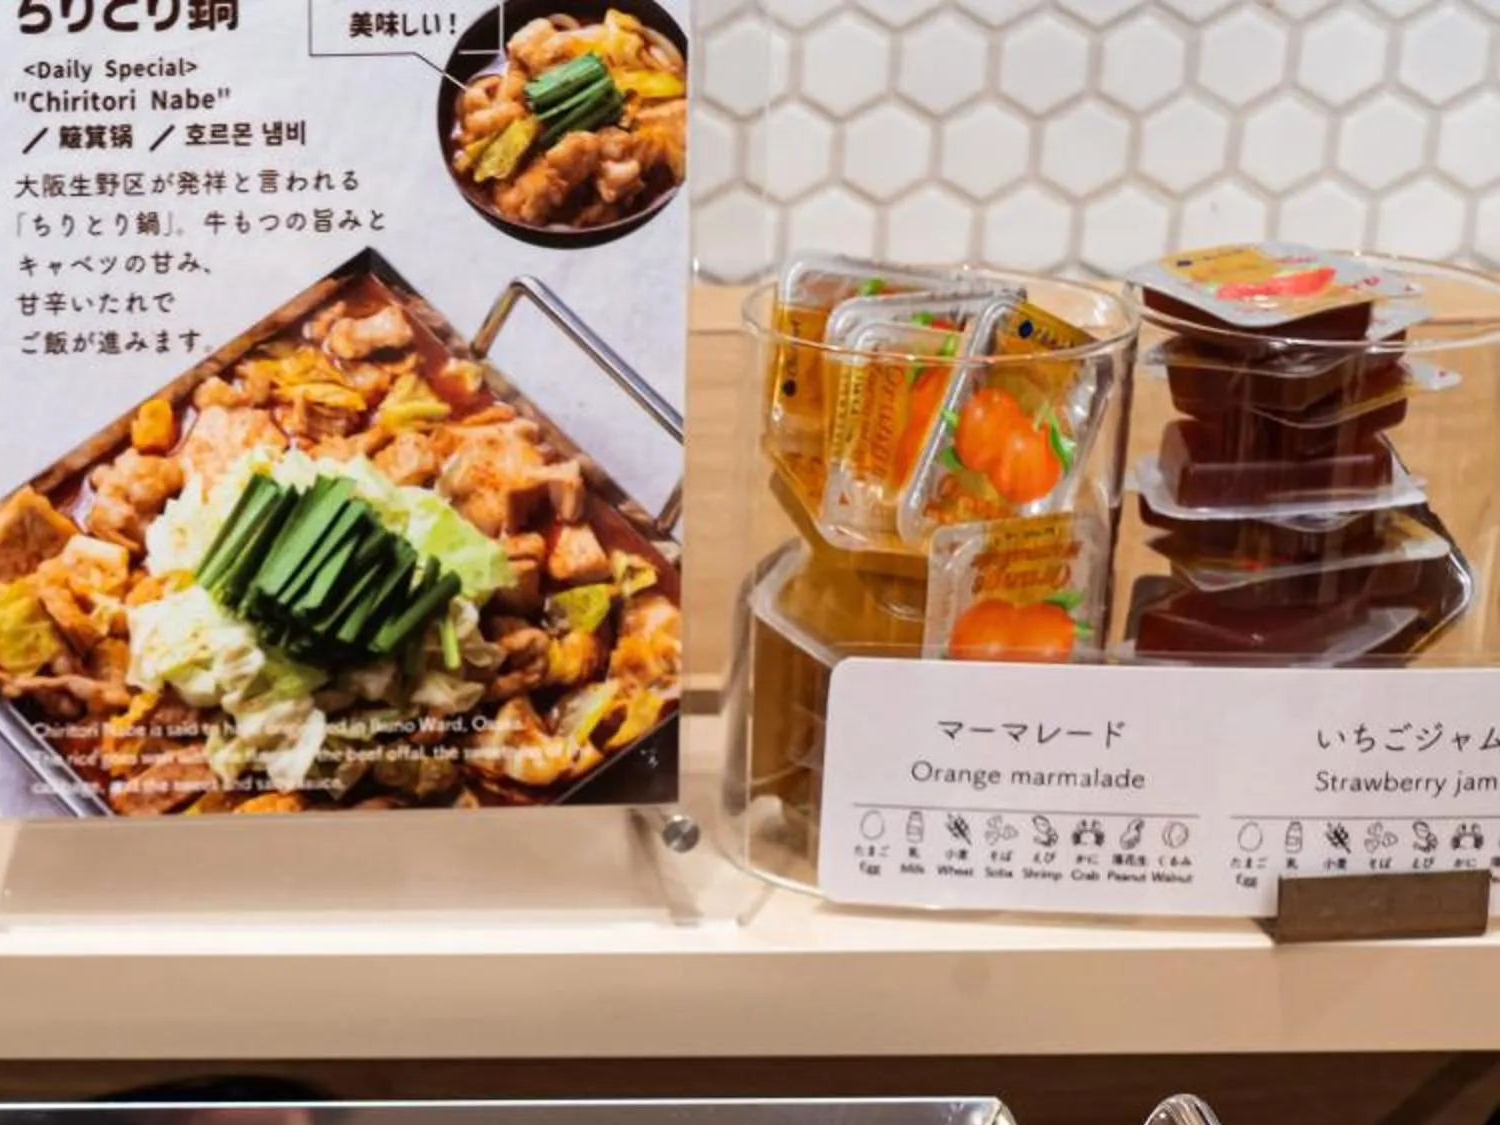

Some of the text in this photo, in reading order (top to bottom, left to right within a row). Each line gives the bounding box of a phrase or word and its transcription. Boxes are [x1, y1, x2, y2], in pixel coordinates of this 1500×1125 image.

[23, 58, 199, 82] <Daily Special>
[13, 87, 232, 113] "Chiritori Nabe"
[185, 123, 254, 147] 호르몬
[262, 120, 307, 146] 냄비
[15, 169, 360, 199] 大阪生野区が発祥と言われる
[17, 292, 176, 316] 甘辛いたれで
[937, 720, 1126, 749] マーマレード
[1316, 721, 1500, 753] いちごジャム
[911, 760, 1146, 791] Orange marmalade
[1315, 770, 1499, 799] Strawberry jam
